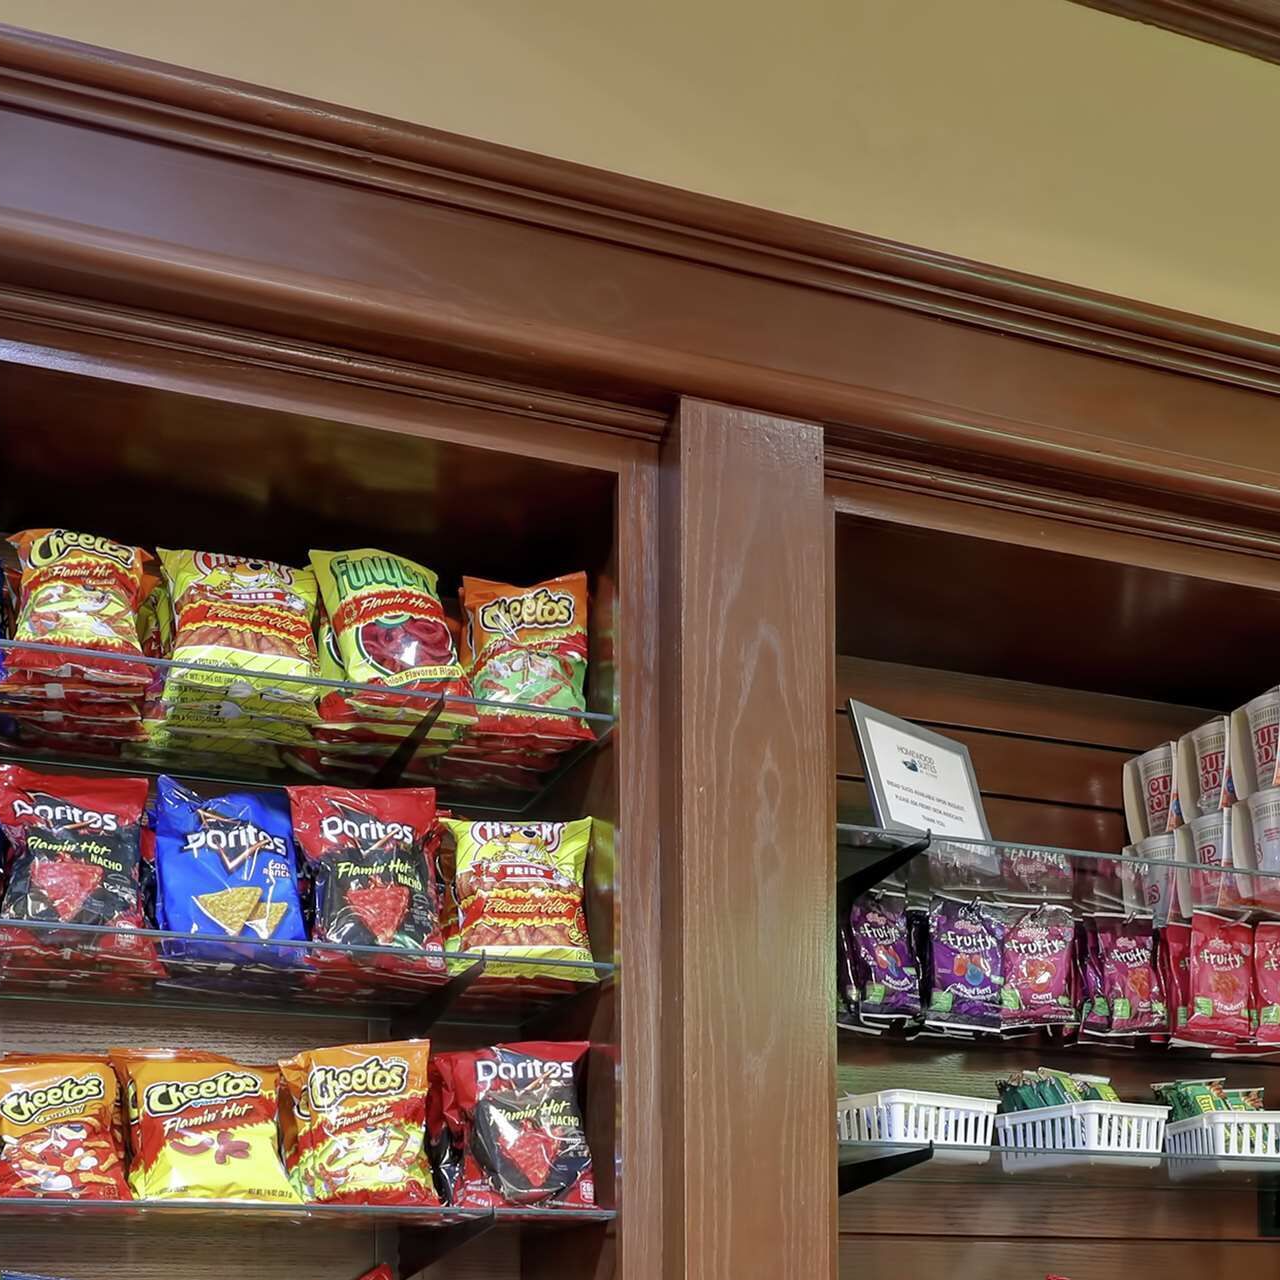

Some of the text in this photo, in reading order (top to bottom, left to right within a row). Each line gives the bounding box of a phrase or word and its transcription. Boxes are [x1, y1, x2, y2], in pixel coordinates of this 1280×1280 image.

[31, 532, 133, 567] Cheetos
[360, 594, 432, 612] Flamin' Hot
[406, 669, 438, 679] Flavored
[13, 800, 117, 831] Doritos
[321, 816, 414, 843] Doritos
[27, 836, 111, 854] Flamin' Hot
[90, 853, 122, 871] NACHO
[337, 861, 411, 876] Flamin' Hot
[507, 866, 544, 877] FRIES
[477, 1060, 573, 1082] Doritos
[311, 1058, 405, 1108] Cheetos
[1, 1078, 102, 1122] Cheetos
[147, 1074, 260, 1115] Cheetos
[35, 1105, 85, 1124] Crunchy
[542, 1100, 567, 1115] Hot
[164, 1103, 249, 1132] Flamin' Hot
[550, 1116, 579, 1127] NACHO
